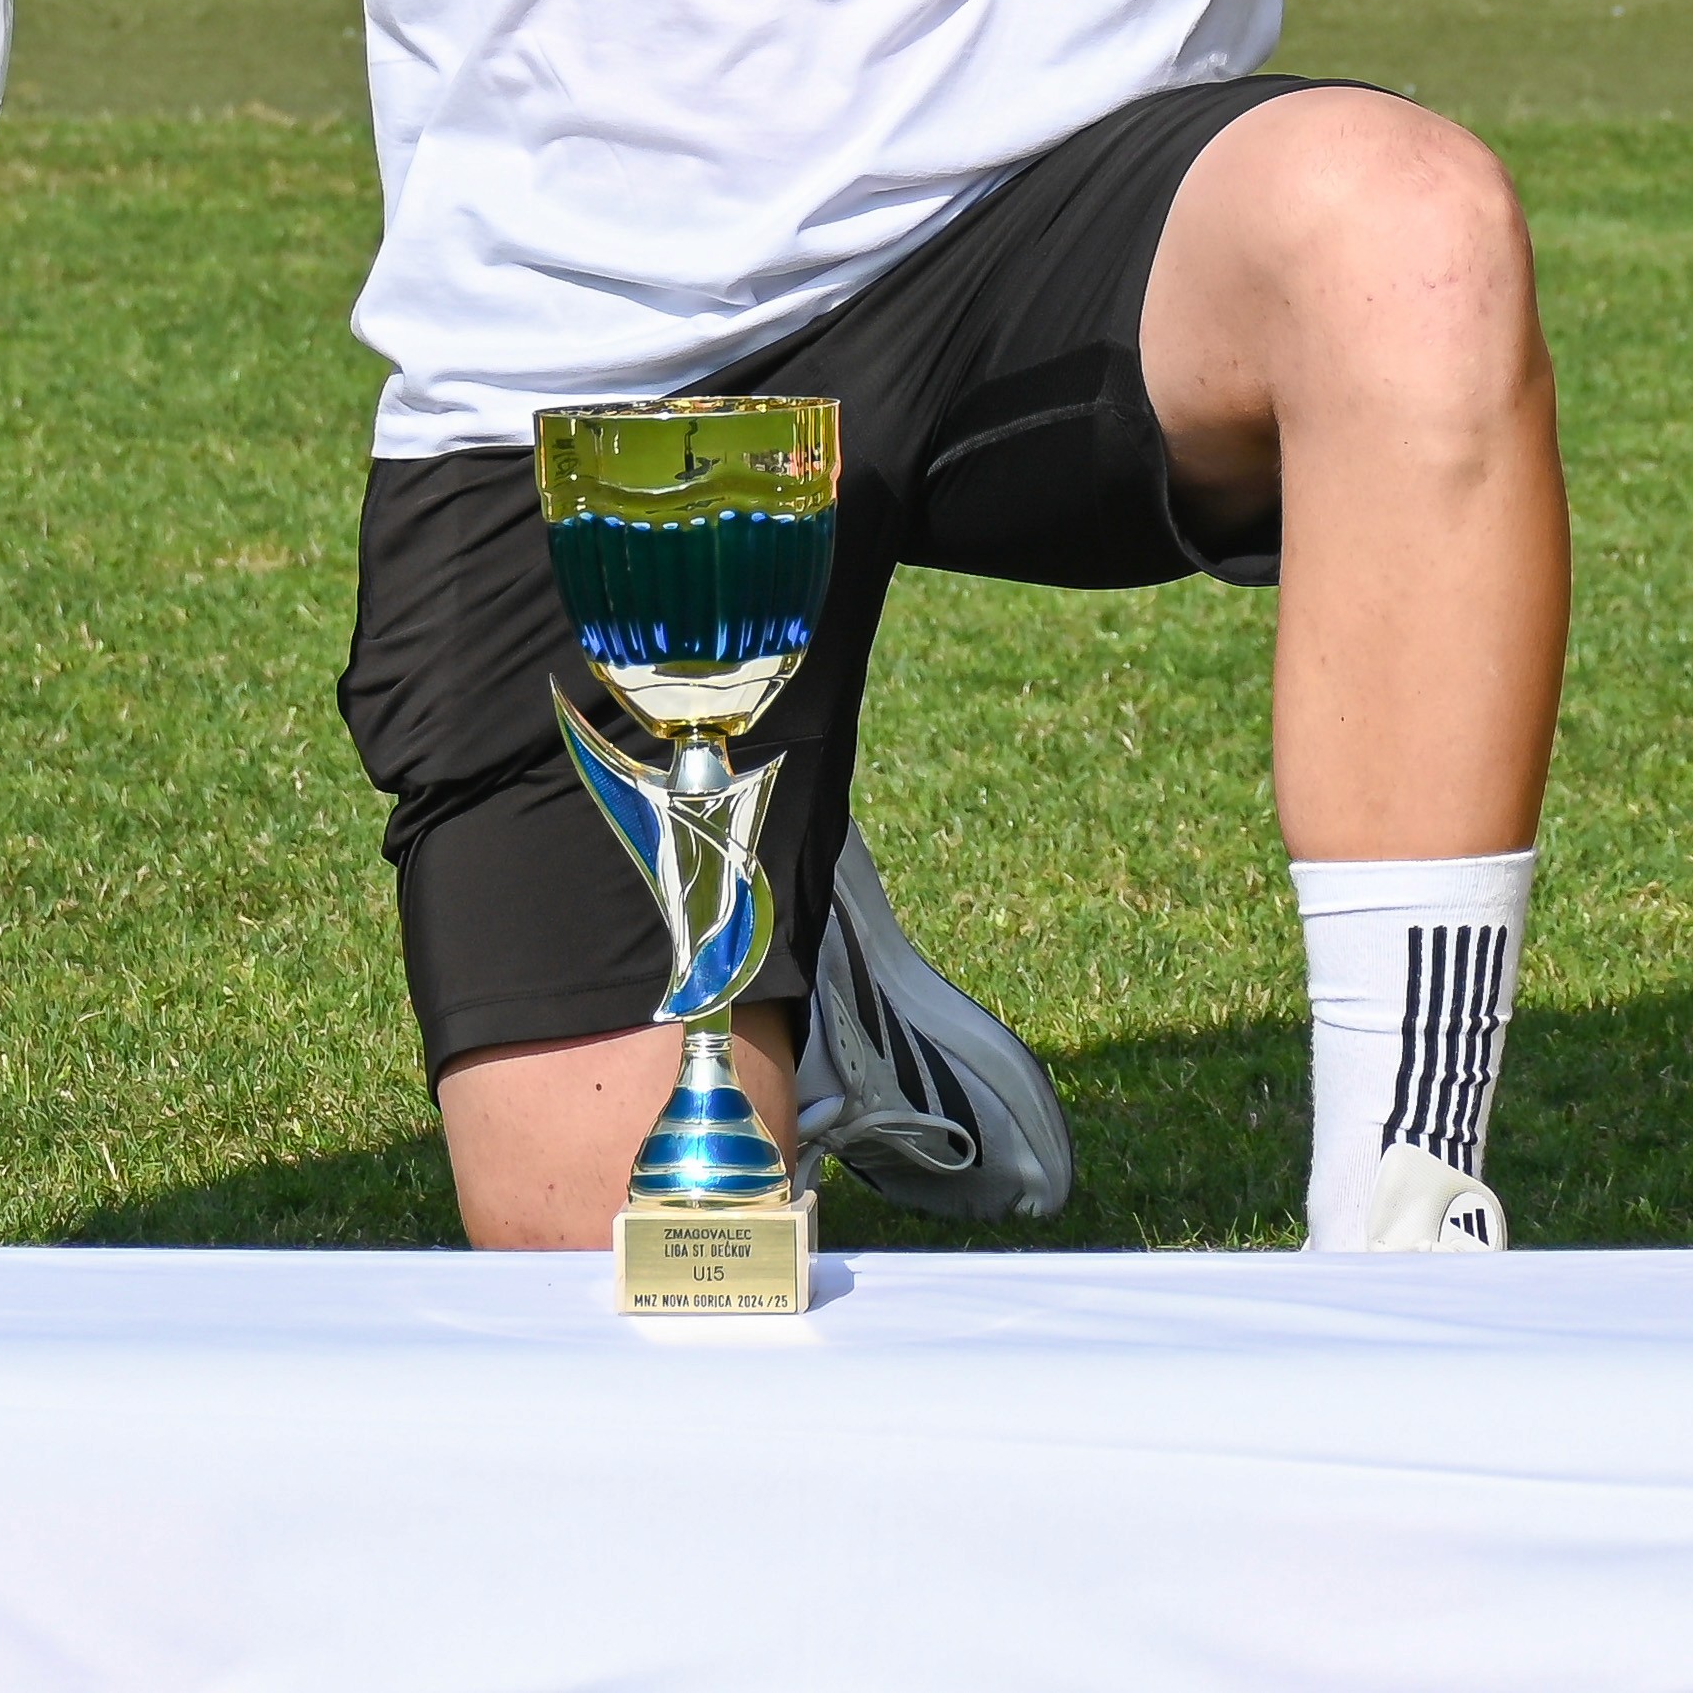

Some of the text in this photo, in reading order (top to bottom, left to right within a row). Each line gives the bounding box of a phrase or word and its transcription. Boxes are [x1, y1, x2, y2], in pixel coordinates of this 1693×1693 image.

[664, 1228, 752, 1240] ZMAGOVALEC
[693, 1266, 725, 1282] U15
[634, 1294, 657, 1308] MNZ
[662, 1294, 689, 1308] NOVA
[693, 1294, 732, 1308] GORICA
